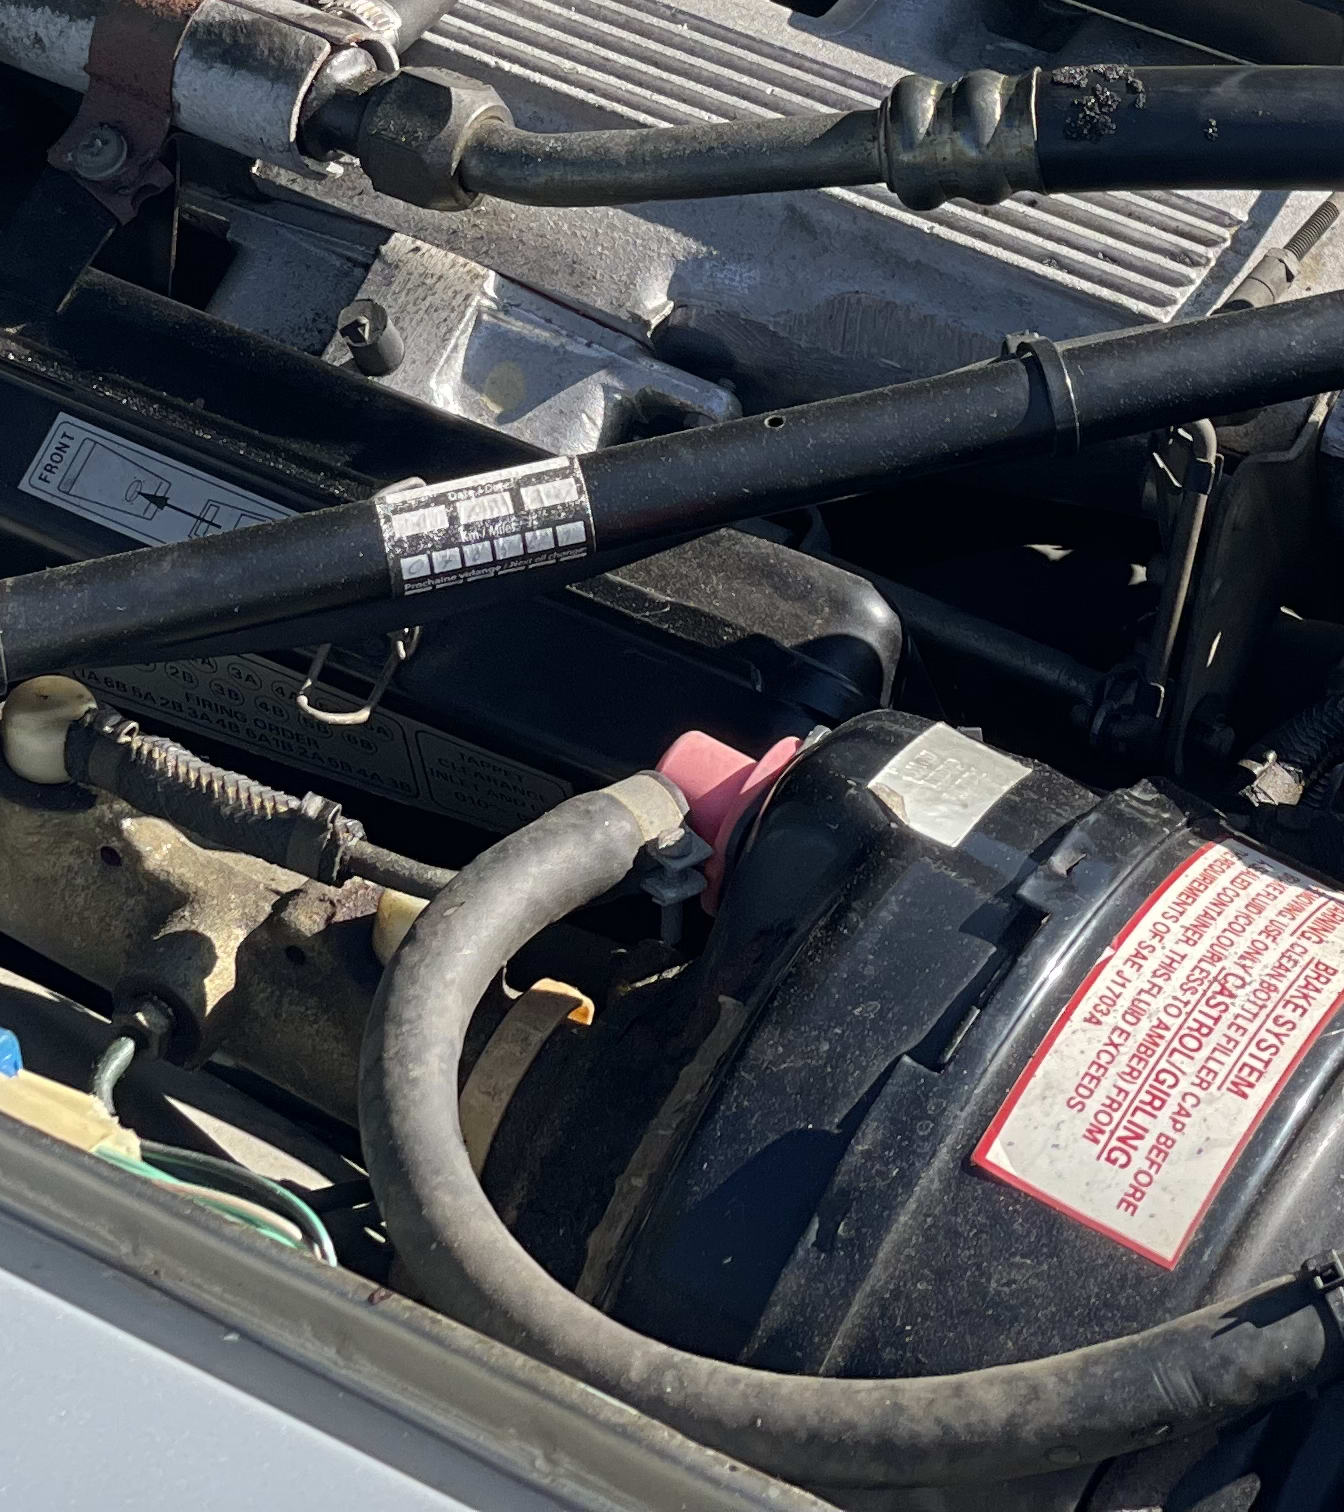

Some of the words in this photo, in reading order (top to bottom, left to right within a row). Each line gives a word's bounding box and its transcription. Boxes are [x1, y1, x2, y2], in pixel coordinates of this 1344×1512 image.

[38, 430, 76, 485] FRONT
[185, 692, 248, 723] FIRING
[253, 717, 320, 750] ORDER
[1159, 854, 1234, 924] REQUIREMENTS
[1173, 885, 1241, 951] CONTAINER.
[1241, 887, 1278, 917] FLUID
[1122, 939, 1157, 972] SAE
[1144, 920, 1173, 944] OF
[1176, 909, 1259, 1000] (COLOURLESS
[1231, 937, 1271, 975] ONLY
[1257, 917, 1287, 943] USE
[1149, 947, 1188, 985] THIS
[1264, 940, 1310, 984] CLEAN
[1281, 959, 1338, 1017] BRAKE
[1081, 968, 1135, 1028] J1703A
[1118, 978, 1166, 1028] FLUID
[1160, 992, 1195, 1022] TO
[1225, 977, 1282, 1039] BOTTLE
[1063, 1025, 1134, 1114] EXCEEDS
[1101, 969, 1250, 1171] CASTROL/GIRLING
[1114, 1016, 1178, 1087] AMBER)
[1188, 1033, 1243, 1093] FILLER
[1226, 1014, 1298, 1101] SYSTEM
[1080, 1083, 1134, 1146] FROM
[1161, 1089, 1206, 1135] CAP
[1114, 1131, 1180, 1217] BEFORE
